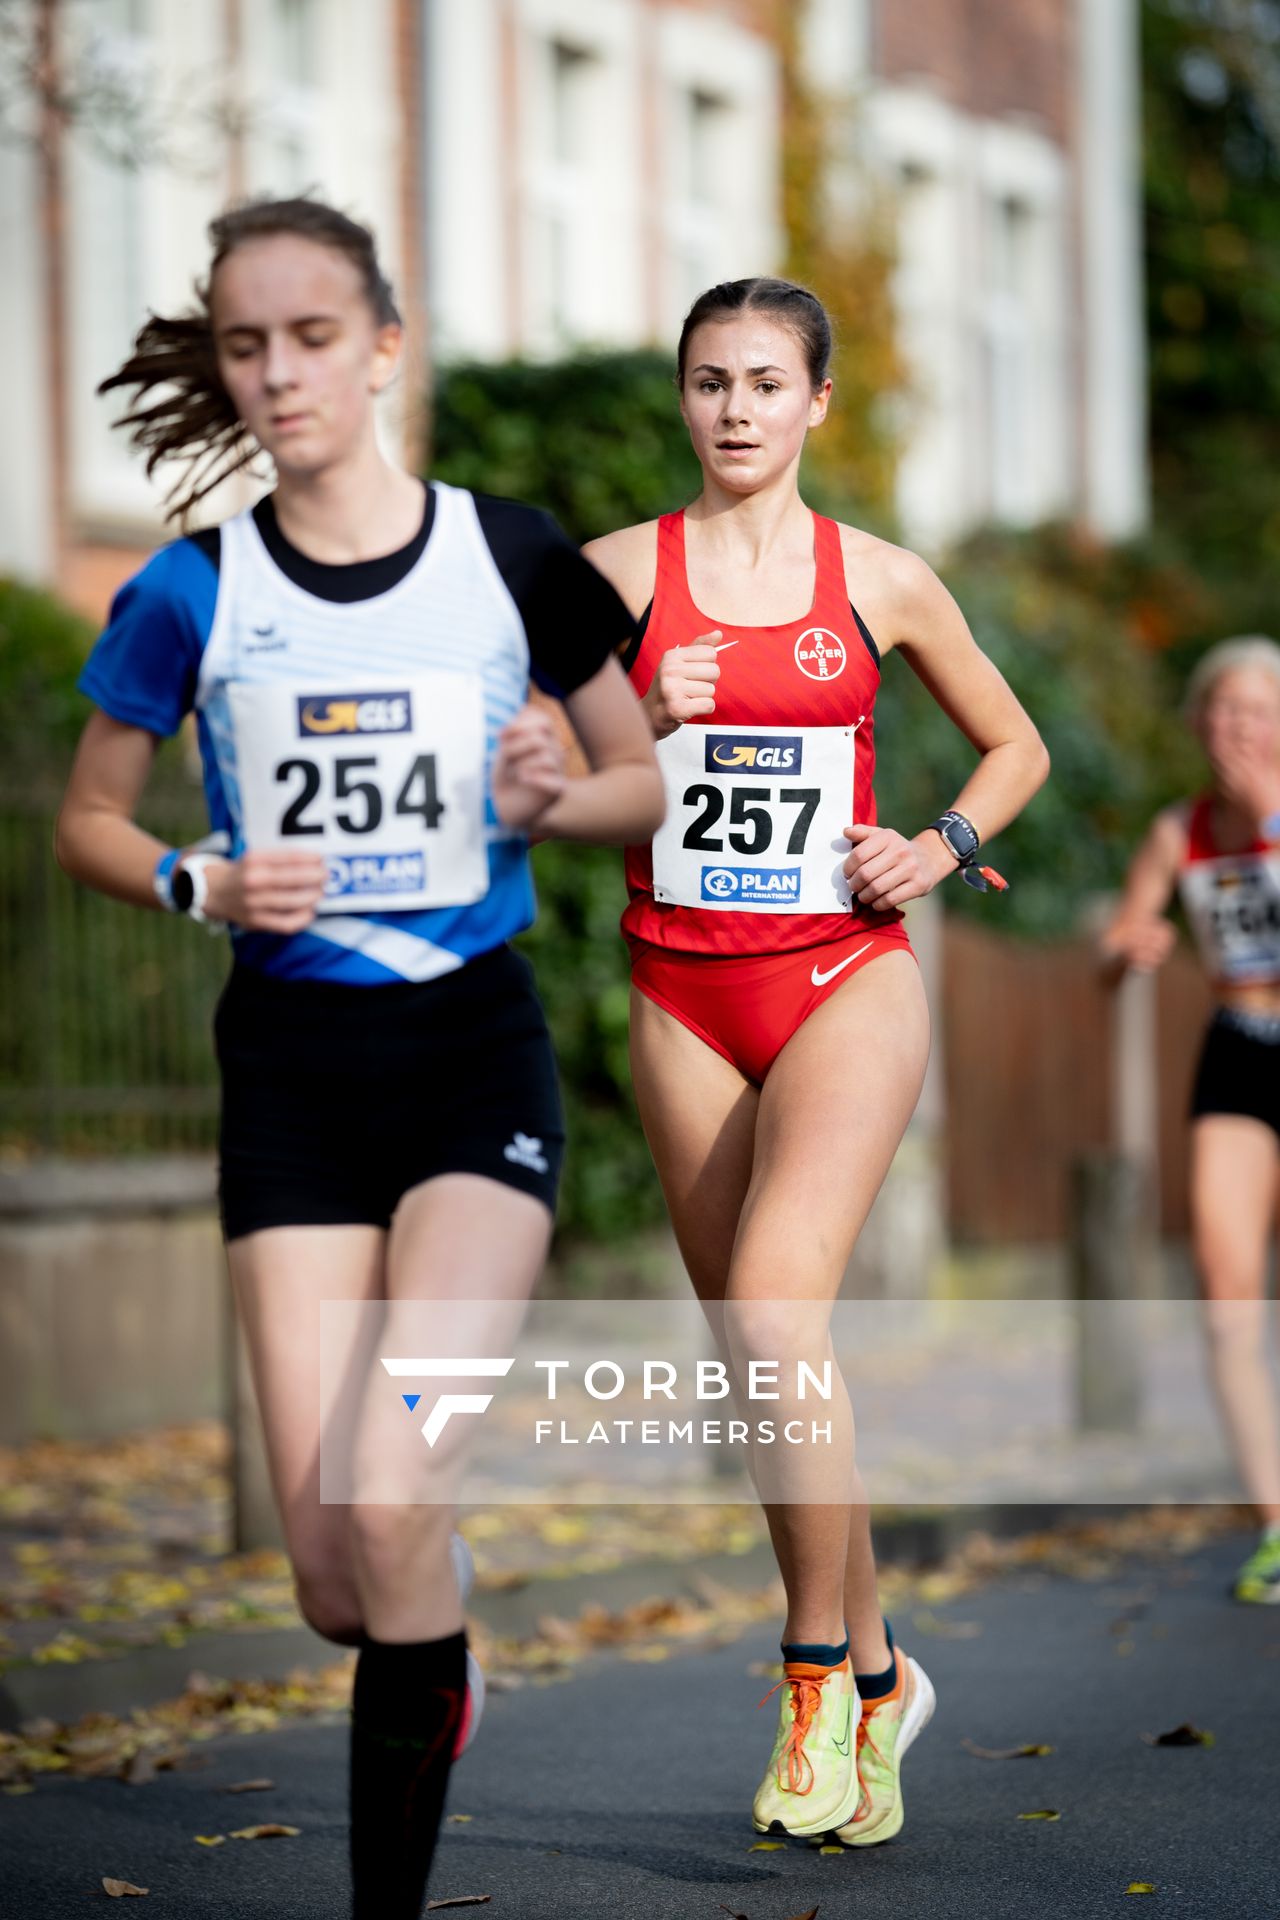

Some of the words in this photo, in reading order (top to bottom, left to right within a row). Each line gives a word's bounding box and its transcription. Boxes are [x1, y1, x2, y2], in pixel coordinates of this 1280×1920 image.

[799, 649, 842, 660] BAYER
[814, 632, 829, 676] BAYER
[357, 698, 408, 731] GLS
[756, 747, 795, 768] GLS
[275, 754, 445, 836] 254
[682, 784, 821, 855] 257
[351, 857, 421, 882] PLAN
[741, 873, 797, 891] PLAN
[741, 892, 797, 900] INTERNATIONAL
